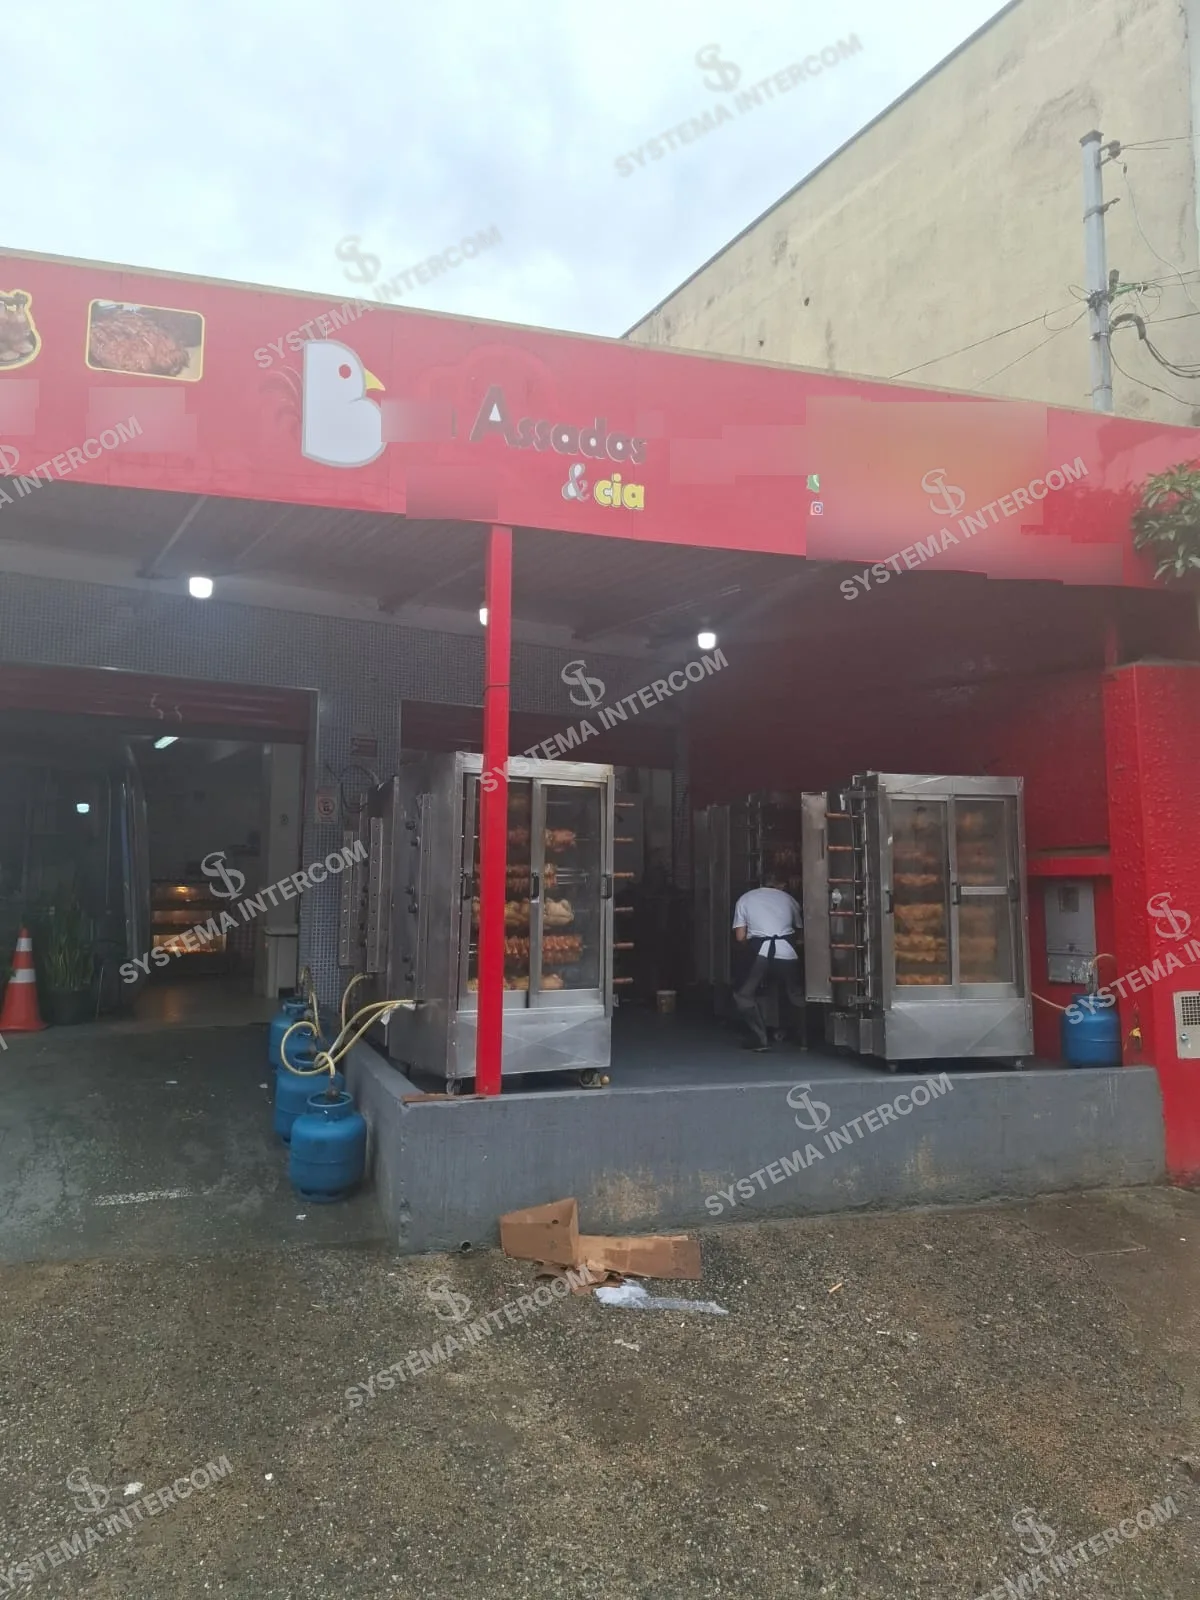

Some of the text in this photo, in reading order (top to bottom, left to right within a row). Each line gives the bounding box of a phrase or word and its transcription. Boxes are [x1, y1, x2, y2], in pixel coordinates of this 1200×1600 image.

[468, 384, 648, 465] Assados
[561, 463, 645, 510] & cia
